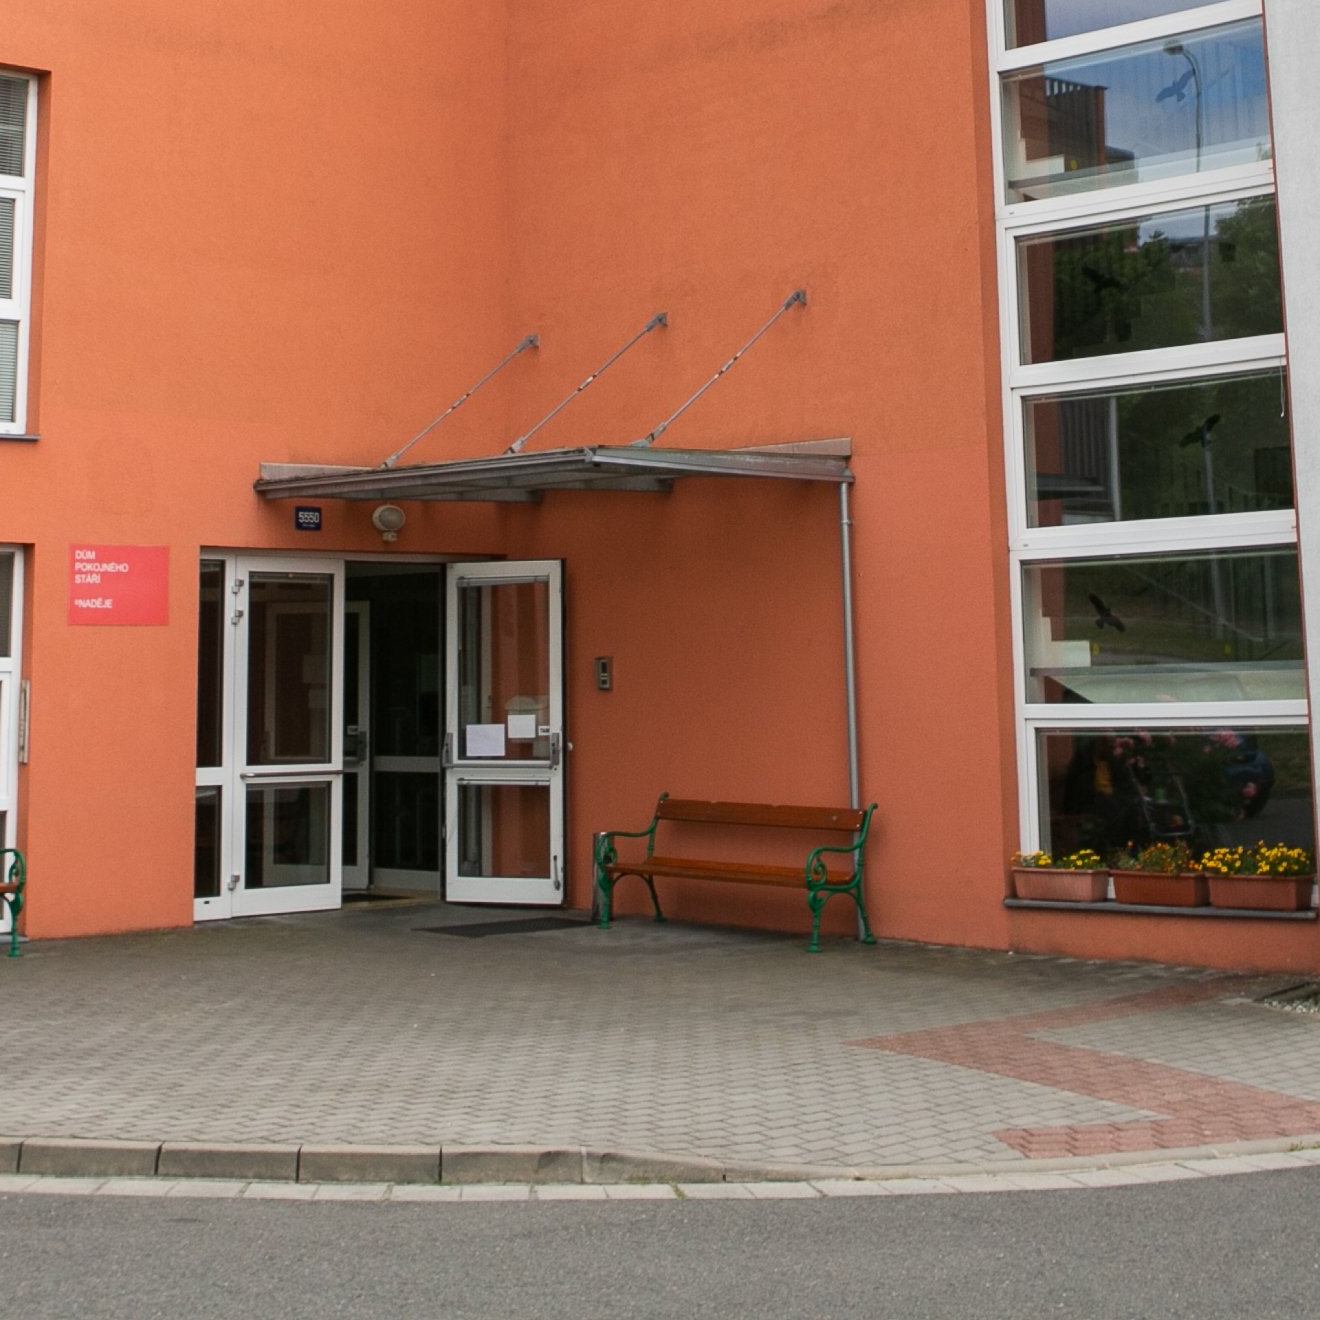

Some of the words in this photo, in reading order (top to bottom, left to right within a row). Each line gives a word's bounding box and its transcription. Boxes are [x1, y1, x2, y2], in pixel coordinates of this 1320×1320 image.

[298, 511, 319, 522] 5550
[75, 549, 95, 559] DŮM
[75, 562, 129, 572] POKOJNÉHO
[75, 573, 100, 584] STÁŘÍ
